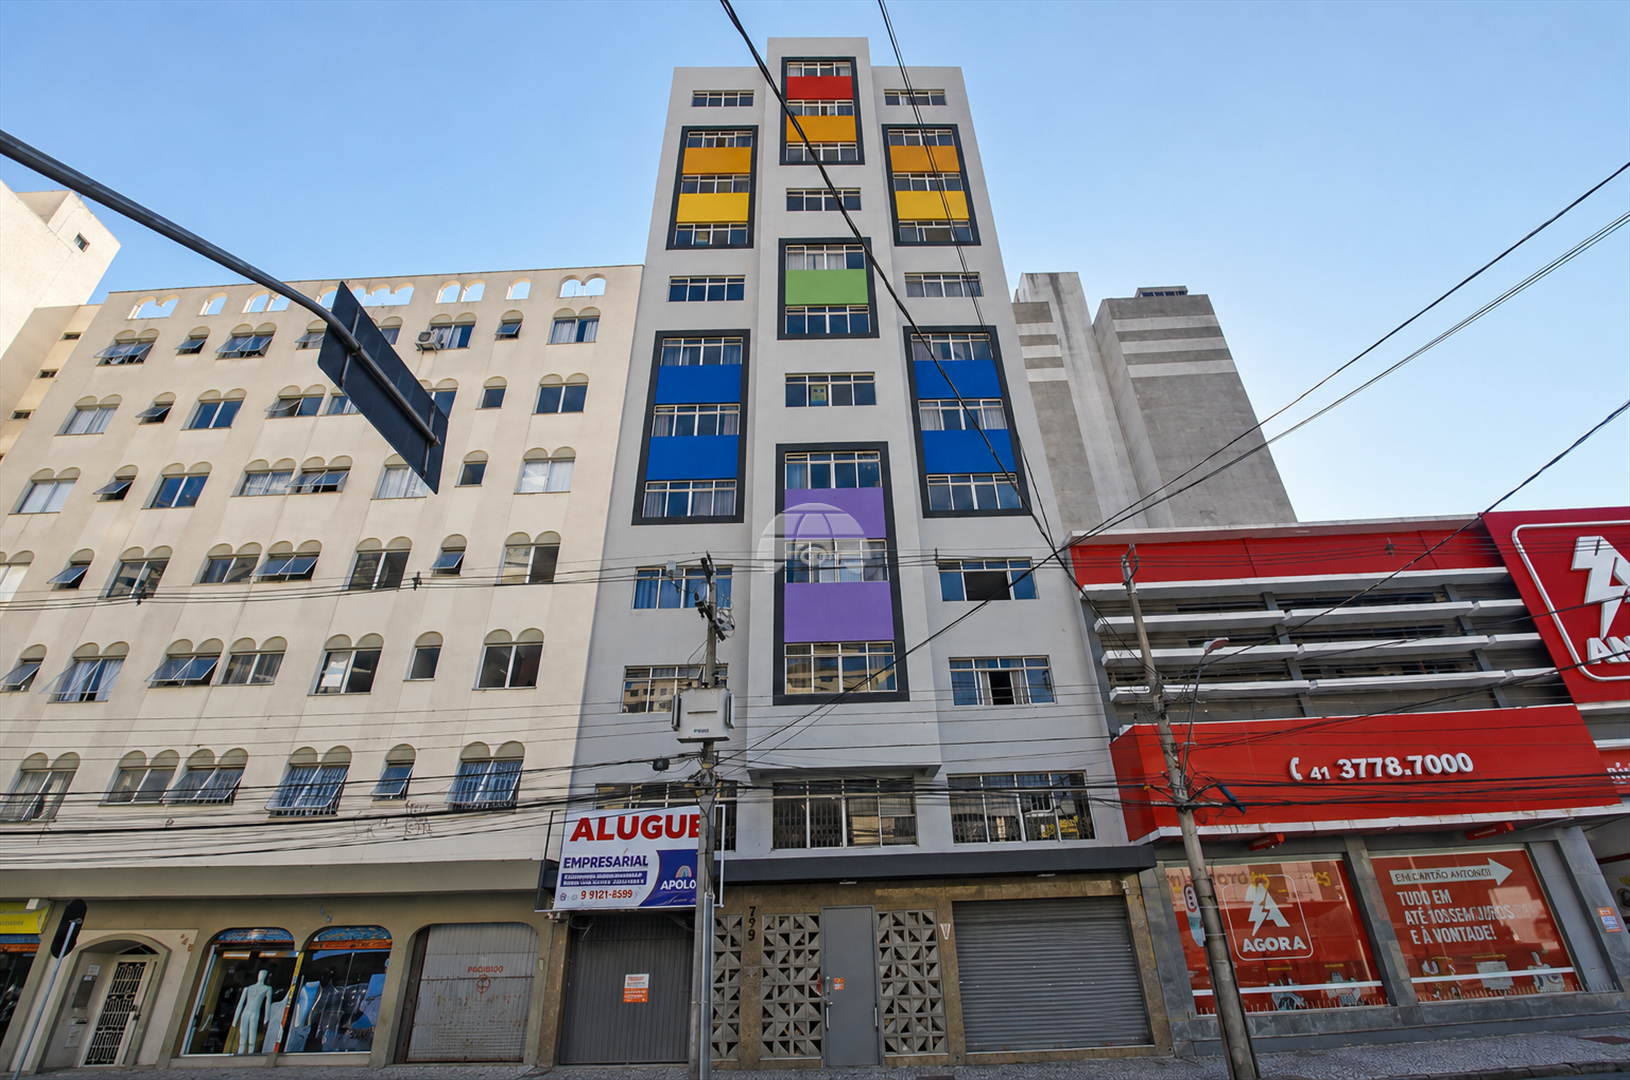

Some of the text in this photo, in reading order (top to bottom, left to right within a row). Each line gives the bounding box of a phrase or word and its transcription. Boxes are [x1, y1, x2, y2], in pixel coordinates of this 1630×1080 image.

[1309, 752, 1474, 780] 41 3778.7000
[569, 814, 700, 842] ALUGUE
[563, 855, 649, 869] EMPRESARIAL
[660, 879, 697, 890] APOLO
[588, 889, 633, 900] 9121-8599
[1397, 889, 1452, 906] TUDO EM
[748, 905, 757, 942] 799
[1404, 907, 1429, 925] ATÉ
[1410, 930, 1421, 945] E
[1432, 924, 1497, 943] VONTADE!
[1242, 936, 1308, 952] AGORA
